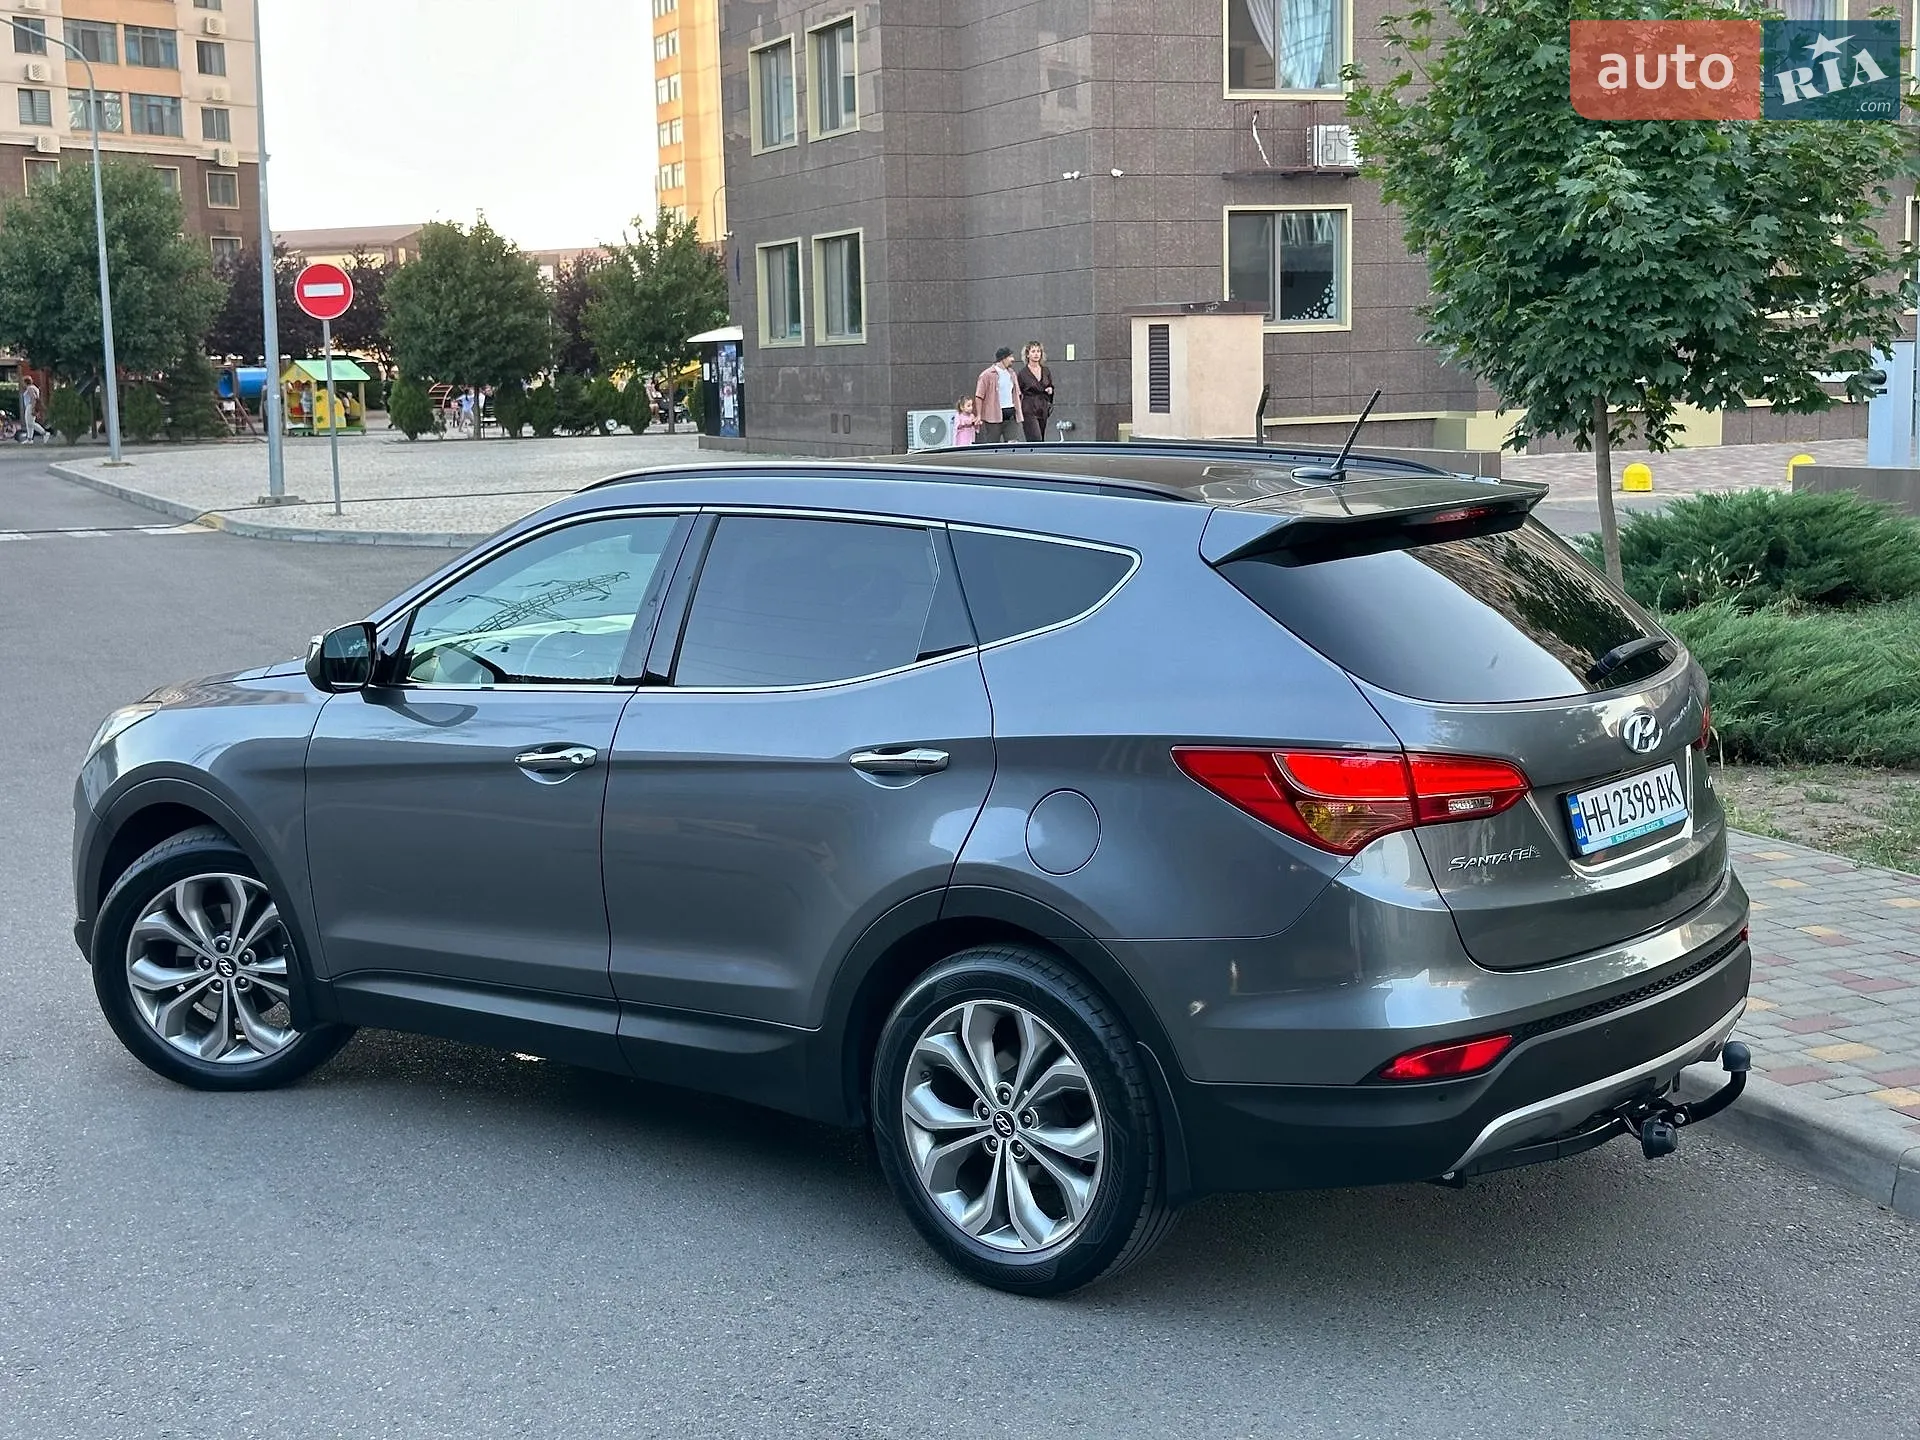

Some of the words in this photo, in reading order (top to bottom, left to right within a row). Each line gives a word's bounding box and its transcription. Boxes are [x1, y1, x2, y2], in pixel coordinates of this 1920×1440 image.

[1581, 793, 1615, 836] HH
[1613, 781, 1656, 826] 2398
[1655, 771, 1681, 811] AK
[1575, 828, 1587, 840] UA
